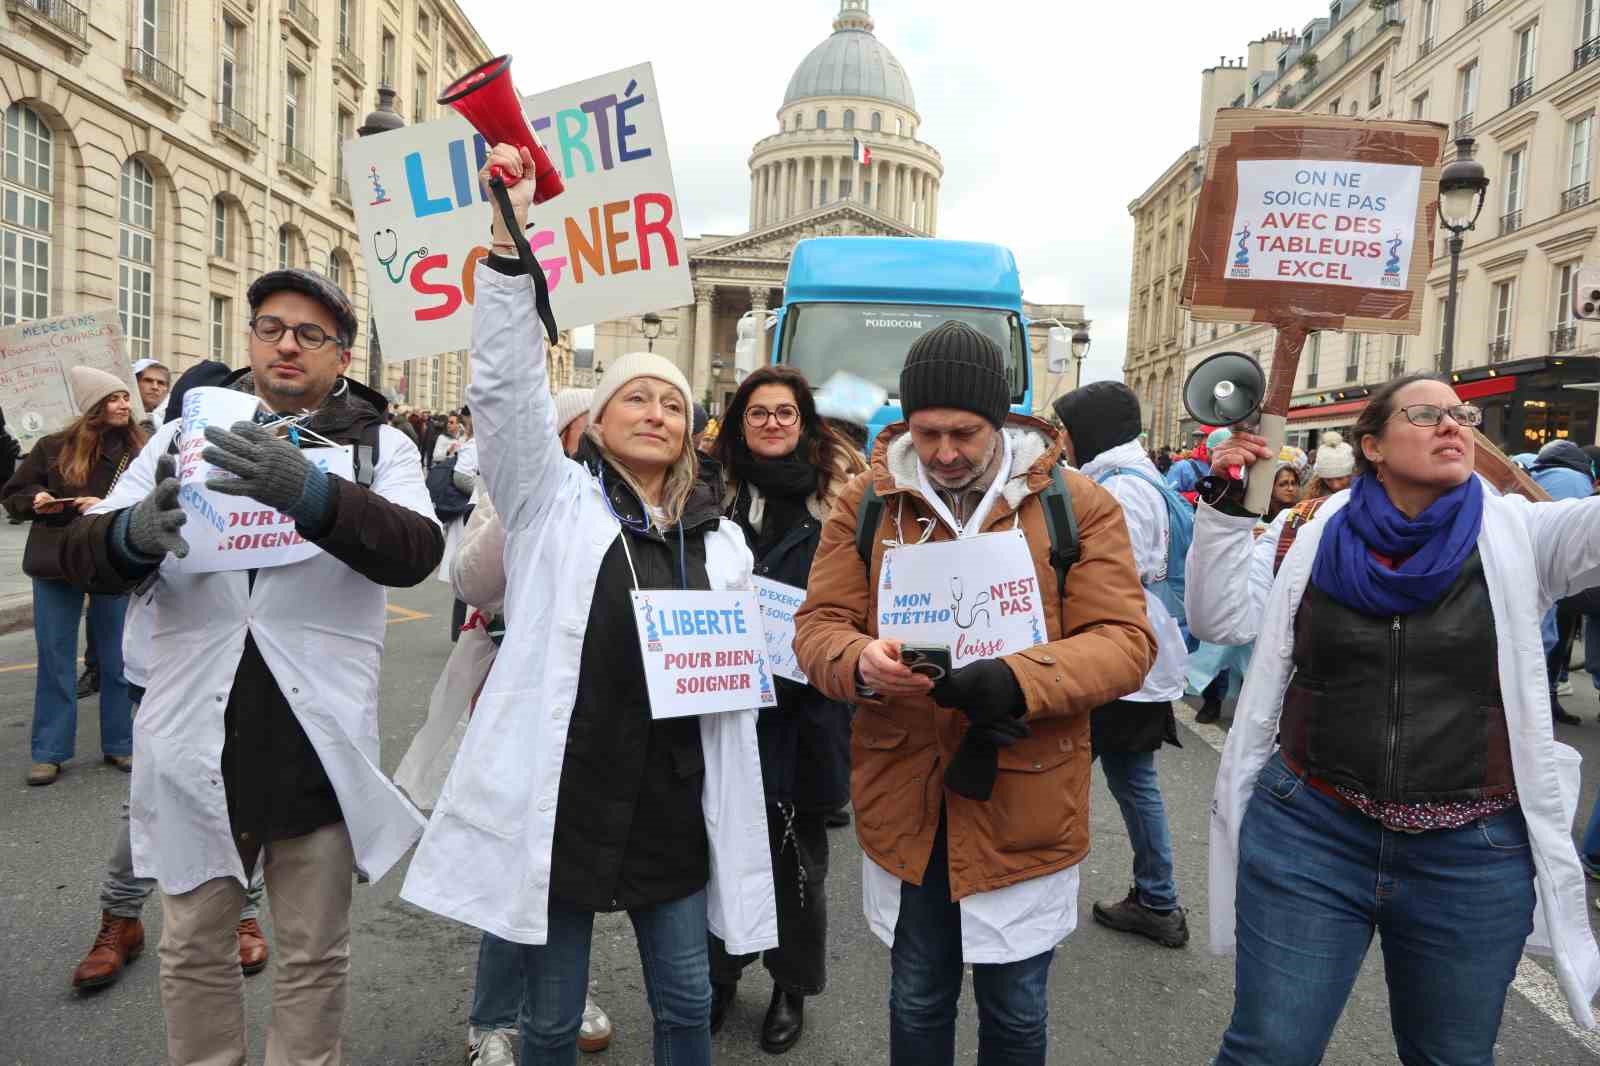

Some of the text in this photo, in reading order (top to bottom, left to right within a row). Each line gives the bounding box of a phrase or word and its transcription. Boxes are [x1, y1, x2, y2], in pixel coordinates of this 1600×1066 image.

[404, 79, 652, 219] LIRTÉ
[1295, 169, 1361, 188] ON NE
[1263, 190, 1387, 212] SOIGNE PAS
[1260, 212, 1382, 234] AVEC DES
[410, 192, 679, 321] SGNER
[1256, 235, 1383, 259] TABLEURS
[1277, 260, 1353, 280] EXCEL
[865, 318, 922, 329] PODIOCOM
[760, 588, 801, 608] D'EXERC
[990, 577, 1035, 601] N'EST
[893, 592, 932, 608] MON
[1000, 596, 1033, 616] PAS
[658, 601, 747, 636] LIBERTÉ
[881, 607, 951, 625] STÉTHO
[955, 632, 1006, 661] laisse
[664, 652, 712, 670] POUR
[715, 649, 754, 668] BIEN
[676, 673, 751, 694] SOIGNER
